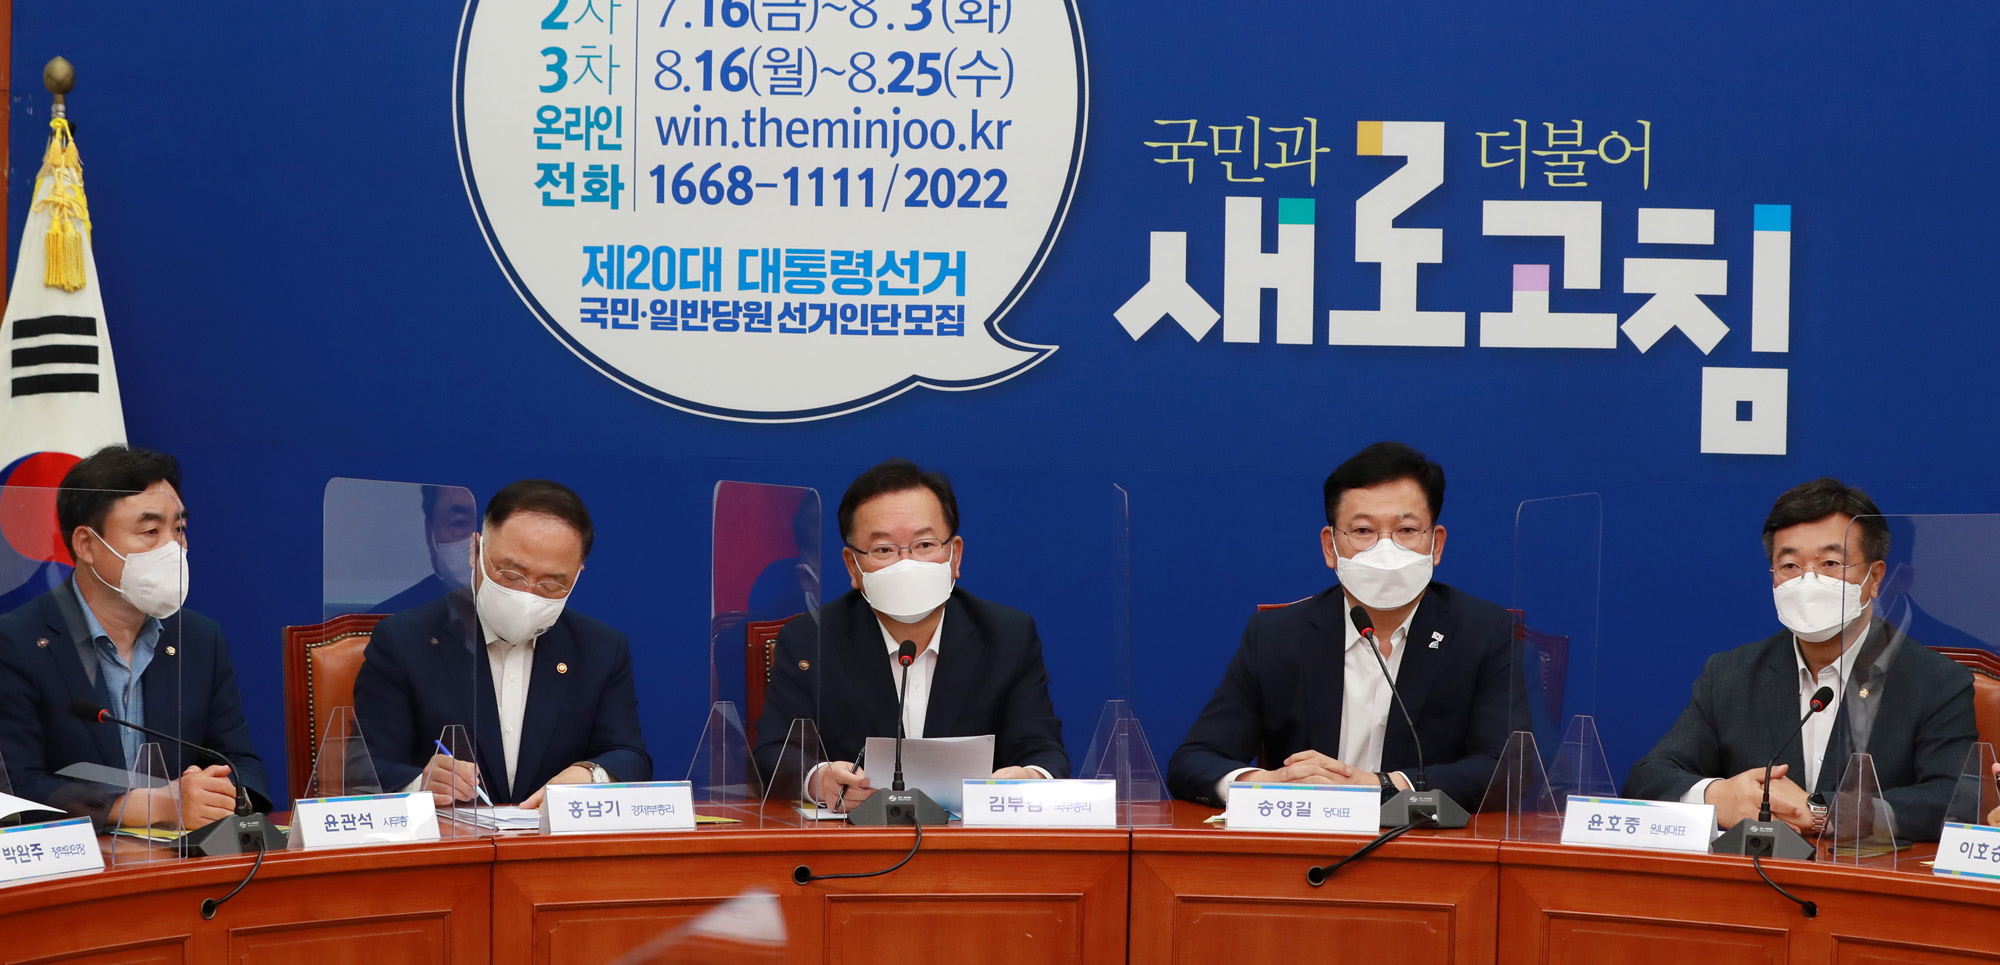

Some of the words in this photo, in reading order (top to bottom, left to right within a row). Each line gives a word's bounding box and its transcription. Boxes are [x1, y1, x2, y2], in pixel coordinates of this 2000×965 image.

[538, 44, 621, 96] 3차
[533, 104, 623, 152] 온라인
[655, 104, 1012, 158] win.theminjoo.kr
[1143, 115, 1331, 187] 국민과
[1475, 119, 1651, 191] 더불어
[534, 161, 625, 210] 전화
[581, 244, 723, 293] 제20대
[738, 247, 967, 297] 대통령선거
[1113, 120, 1791, 456] 새로고침
[324, 812, 374, 832] 윤관석
[568, 800, 620, 819] 홍남기
[1257, 800, 1311, 818] 송영길
[1323, 807, 1351, 818] 당대표
[1588, 814, 1640, 834] 윤호중
[1650, 824, 1686, 836] 원내대표
[2, 843, 44, 864] 박완주
